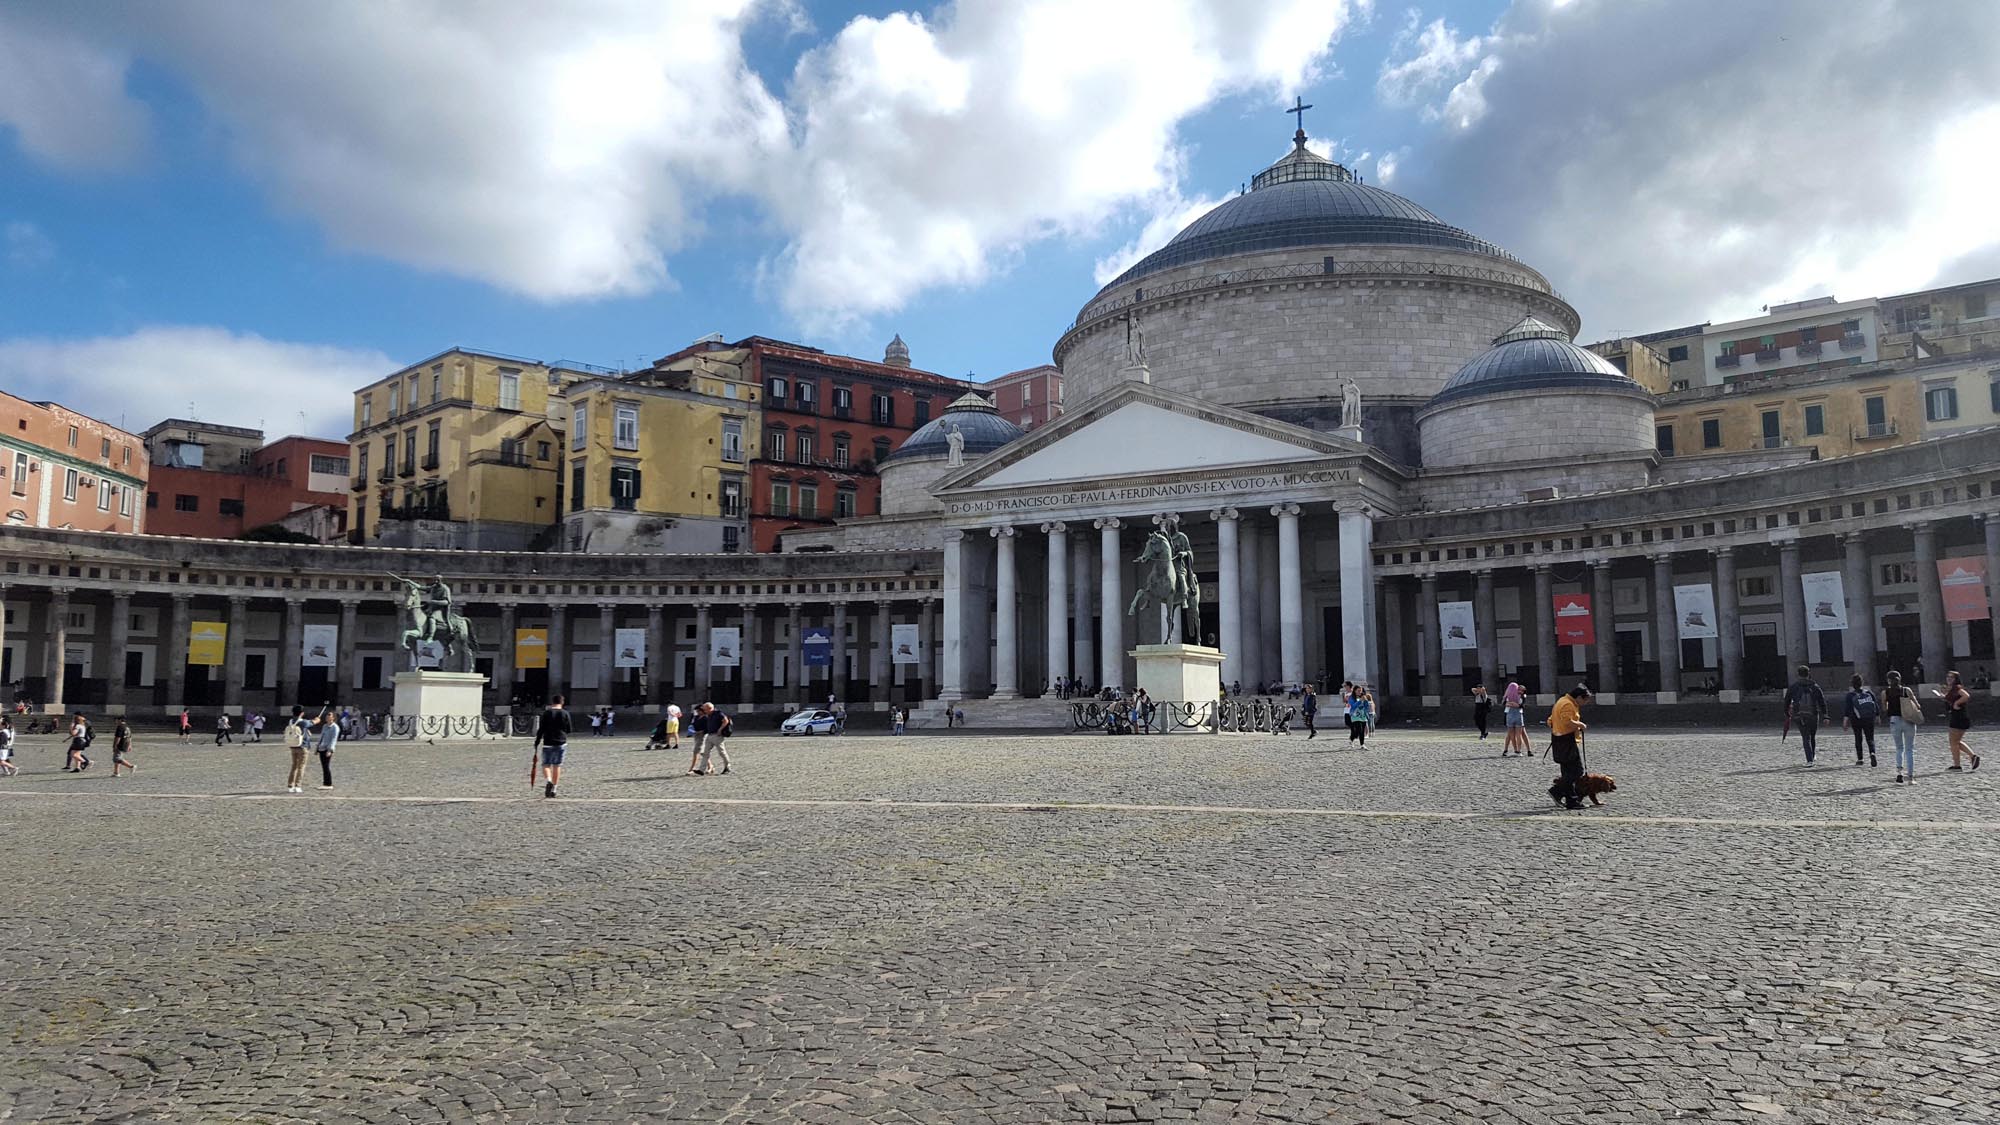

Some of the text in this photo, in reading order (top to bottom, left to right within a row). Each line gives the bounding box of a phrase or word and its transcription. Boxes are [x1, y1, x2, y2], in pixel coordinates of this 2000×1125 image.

[997, 495, 1059, 510] FRANCISCO
[1062, 494, 1077, 504] DE
[1081, 491, 1116, 503] PAVLA
[1120, 483, 1200, 499] FERDINANDVS
[1211, 481, 1226, 492] EX
[1231, 478, 1266, 489] VOTO
[1270, 477, 1279, 487] A
[1283, 470, 1350, 486] MDCCCXVI
